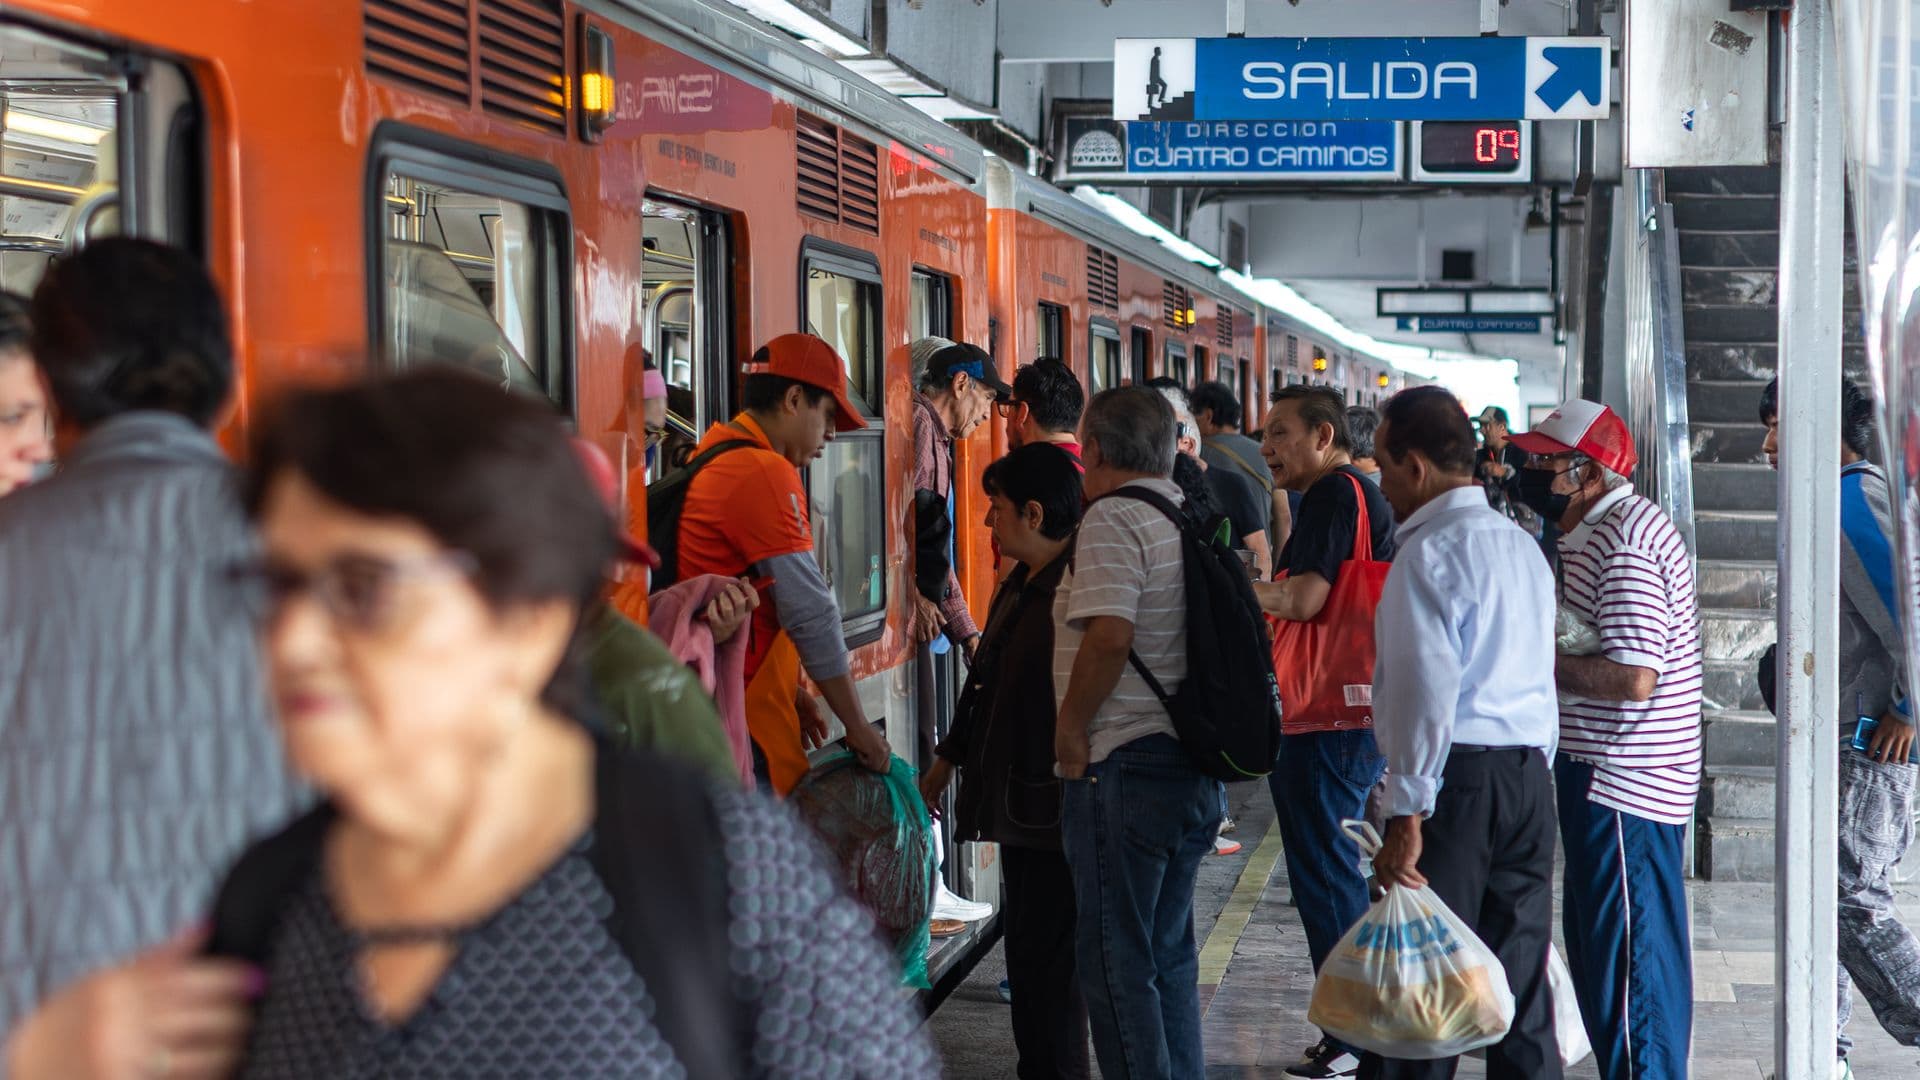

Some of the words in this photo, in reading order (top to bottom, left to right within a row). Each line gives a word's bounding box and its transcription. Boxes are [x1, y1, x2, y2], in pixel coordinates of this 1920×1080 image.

[1242, 61, 1478, 99] SALIDA
[1186, 122, 1337, 138] DIRECCION
[1134, 146, 1249, 166] CUATRO
[1258, 145, 1388, 166] CAMINOS
[1475, 129, 1519, 161] 09
[1423, 318, 1474, 329] CUATRO
